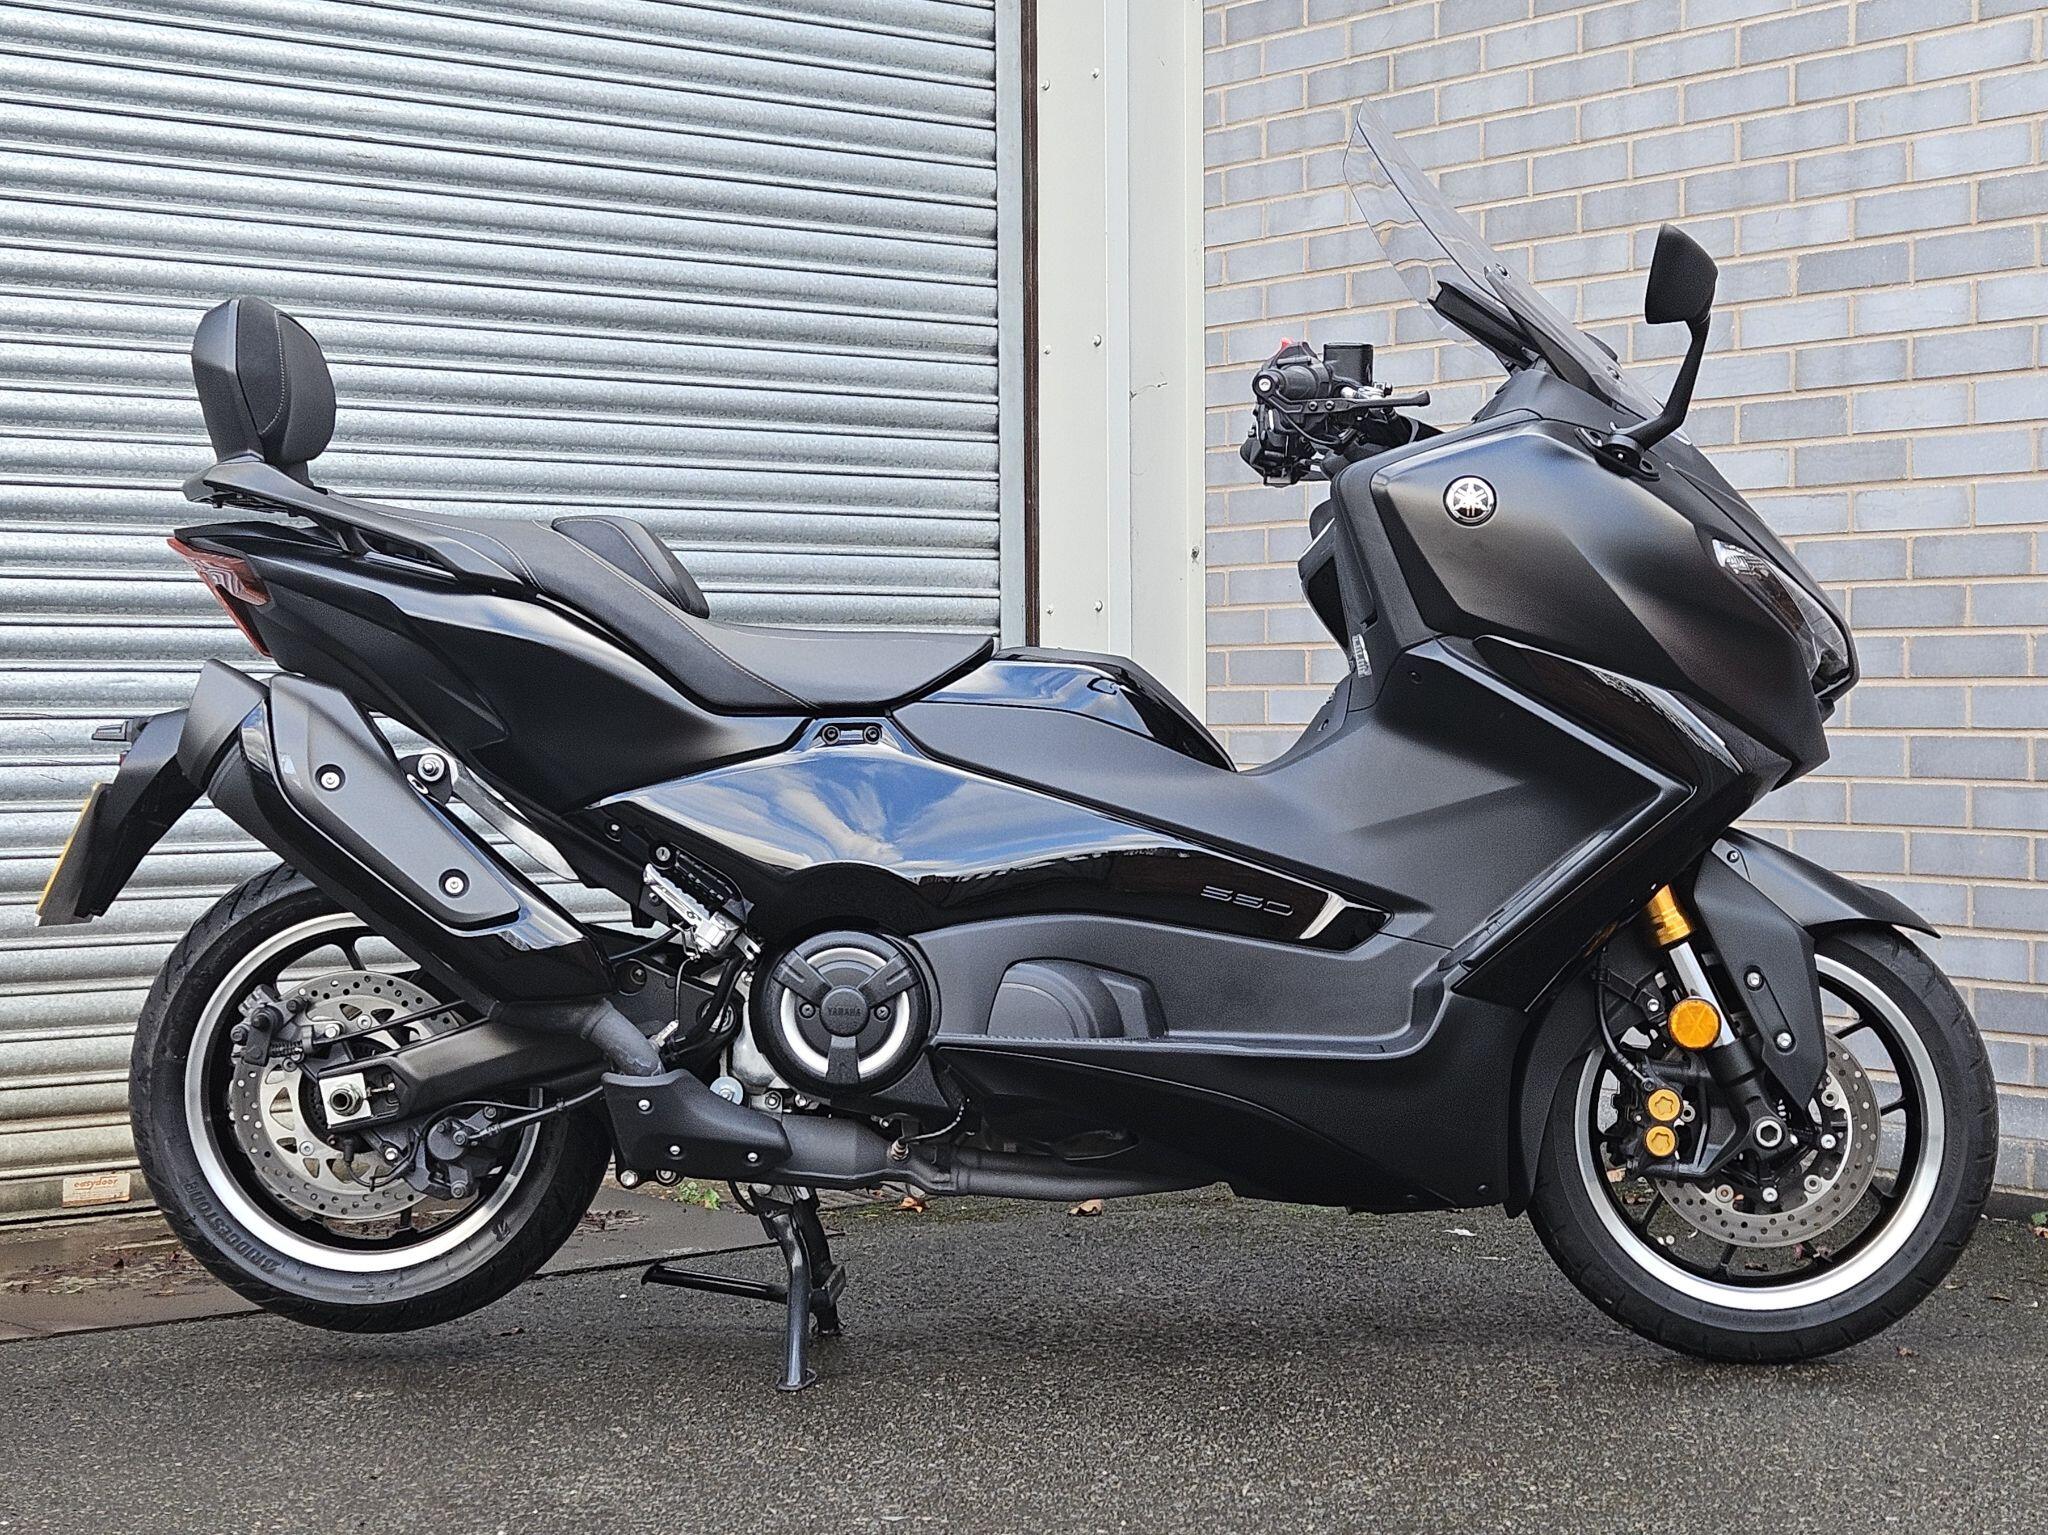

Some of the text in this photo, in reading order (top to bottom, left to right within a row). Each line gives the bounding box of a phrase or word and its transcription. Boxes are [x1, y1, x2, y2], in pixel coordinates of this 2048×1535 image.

[828, 1006, 862, 1017] YAMAHA
[73, 1175, 119, 1191] easydoor
[183, 1180, 281, 1275] BRIDGESTONE
